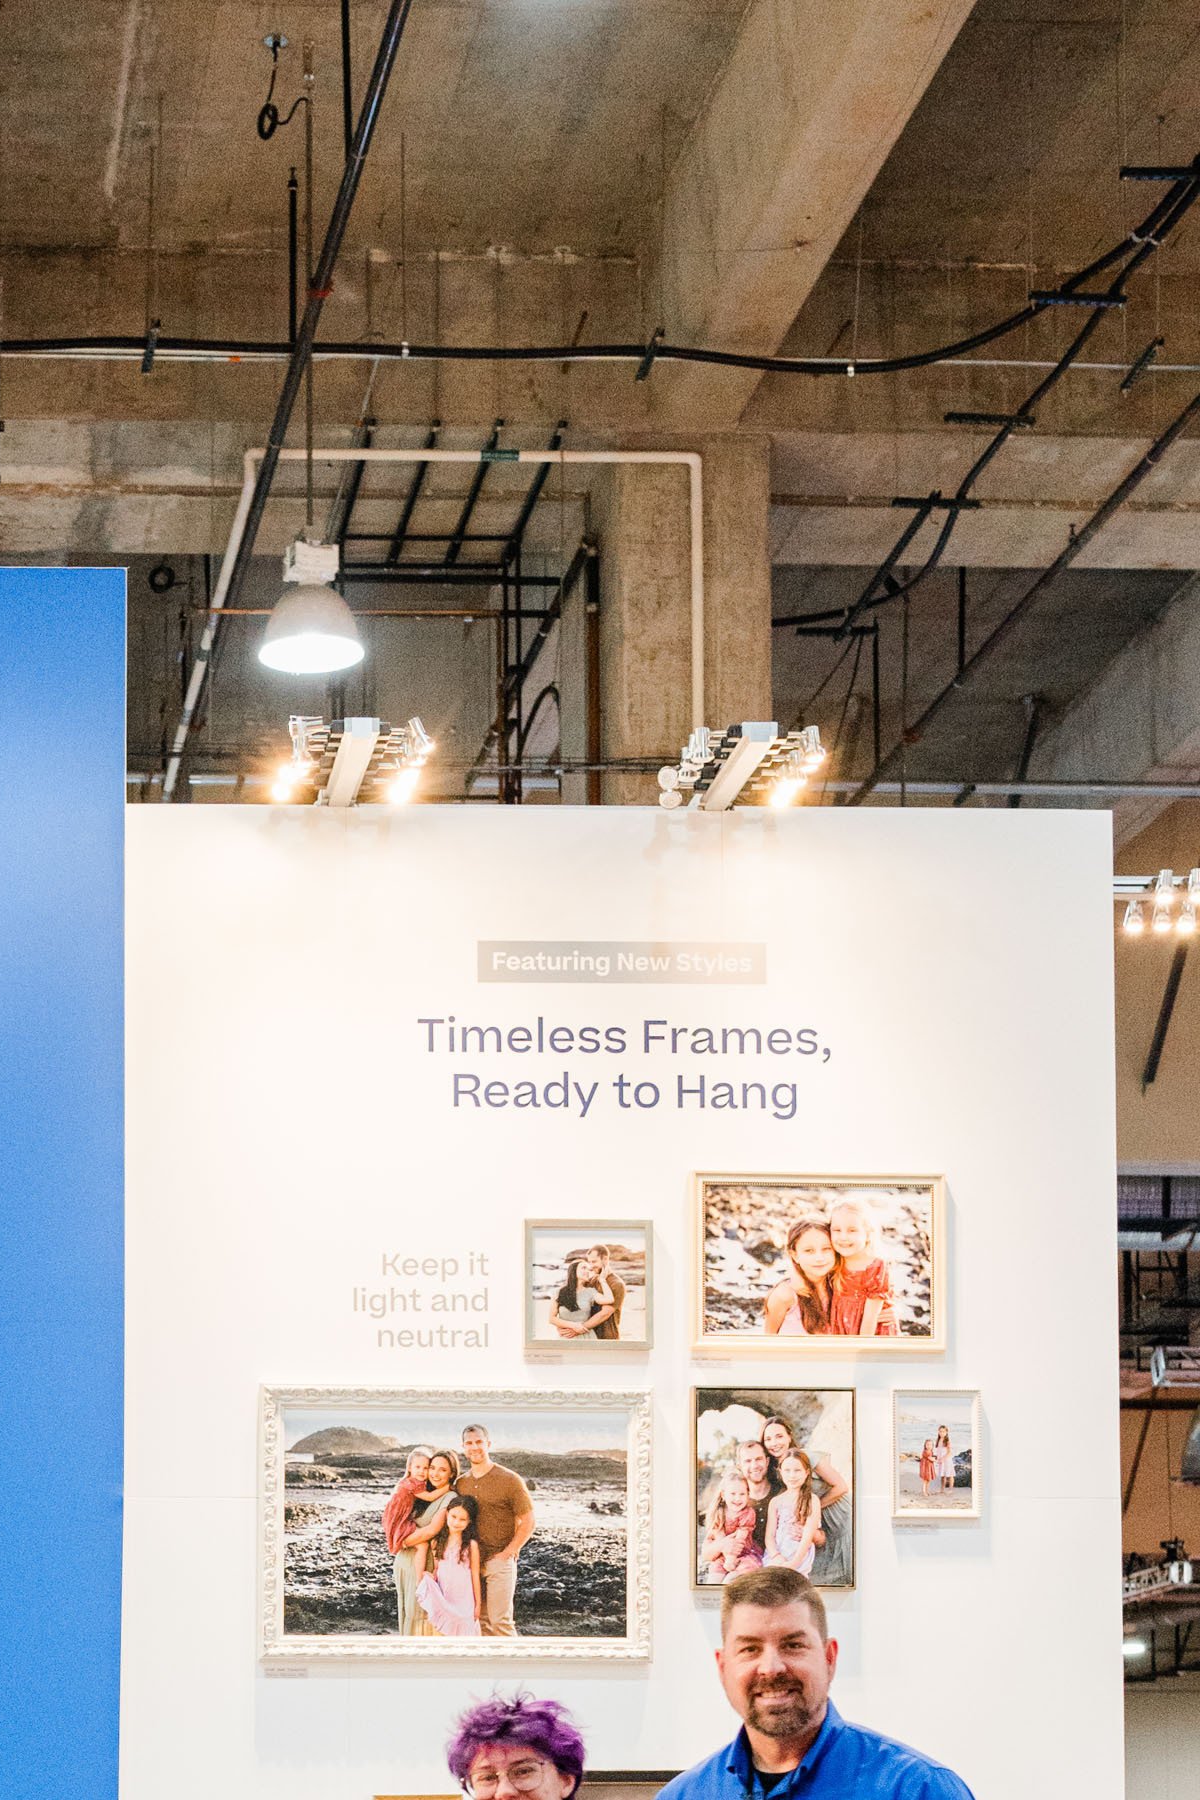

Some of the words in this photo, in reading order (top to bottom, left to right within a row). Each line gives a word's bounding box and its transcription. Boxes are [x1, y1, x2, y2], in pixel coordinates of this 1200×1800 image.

[491, 951, 610, 976] Featuring
[617, 952, 670, 972] New
[676, 953, 752, 976] Styles
[417, 1016, 627, 1054] Timeless
[643, 1020, 831, 1063] Frames,
[452, 1071, 599, 1118] Ready
[612, 1073, 660, 1109] to
[677, 1075, 798, 1120] Hang
[382, 1252, 460, 1282] Keep
[469, 1251, 489, 1276] it
[353, 1287, 422, 1319] light
[431, 1287, 489, 1312] and
[377, 1323, 489, 1348] neutral
